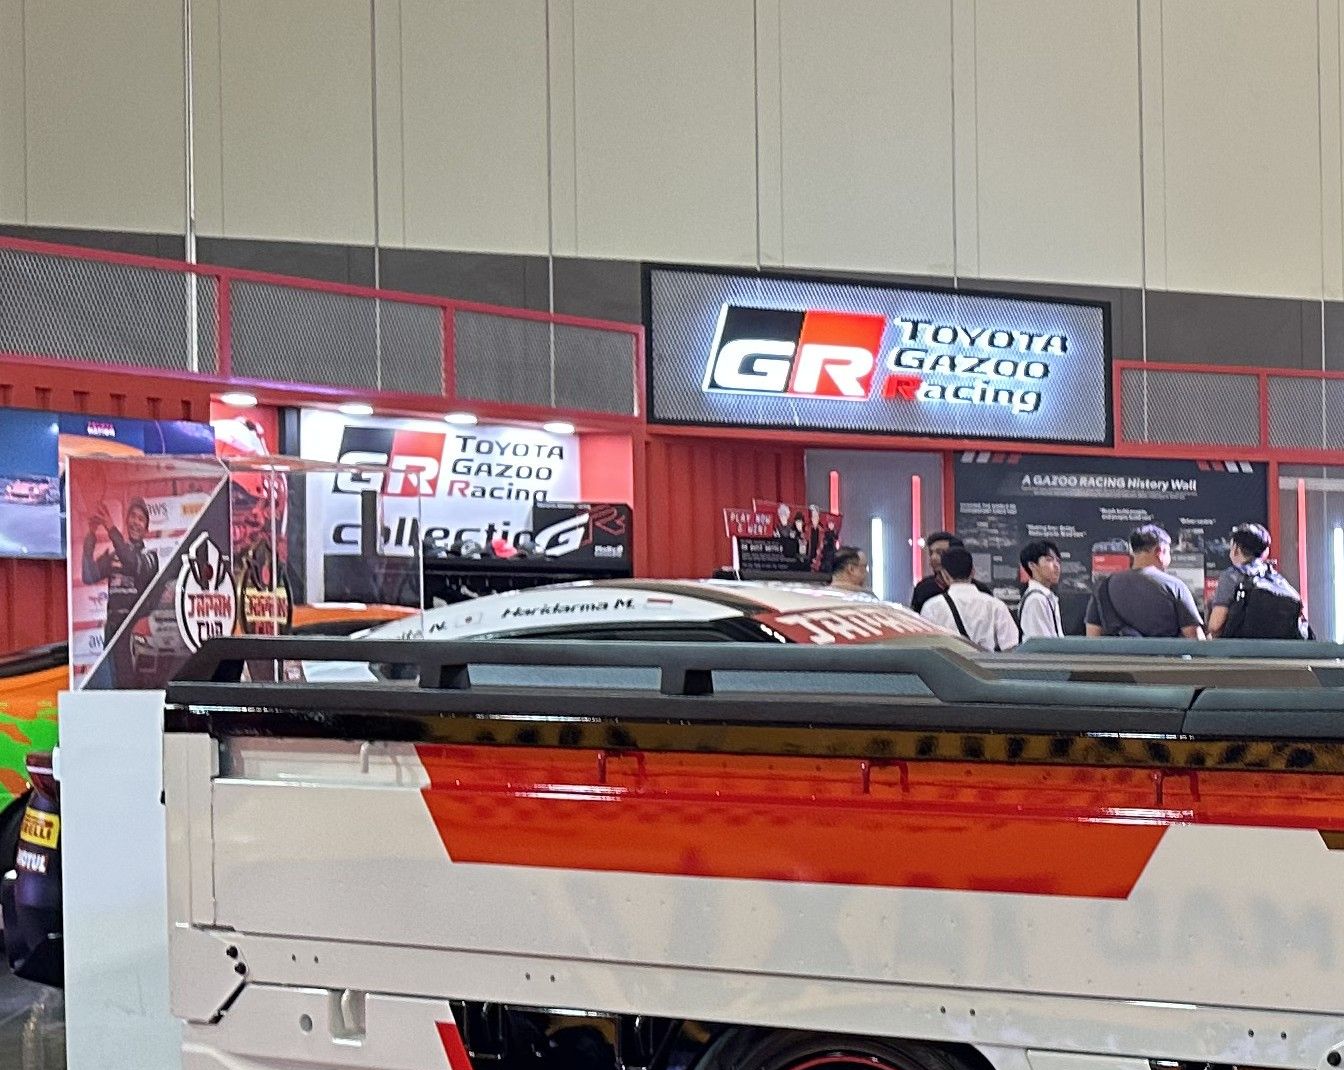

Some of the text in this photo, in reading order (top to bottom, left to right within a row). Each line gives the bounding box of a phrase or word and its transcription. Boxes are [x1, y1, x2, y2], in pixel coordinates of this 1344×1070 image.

[896, 315, 1069, 354] TOYOTA
[712, 337, 876, 398] GR
[892, 347, 1050, 379] GAZOO
[884, 374, 1043, 413] Racing
[455, 435, 564, 460] TOYOTA
[333, 450, 440, 496] GR
[452, 458, 552, 480] GAZOO
[448, 480, 548, 502] Racing
[1079, 476, 1126, 489] RACING
[1171, 479, 1198, 491] Wall
[187, 593, 232, 618] JAPAN
